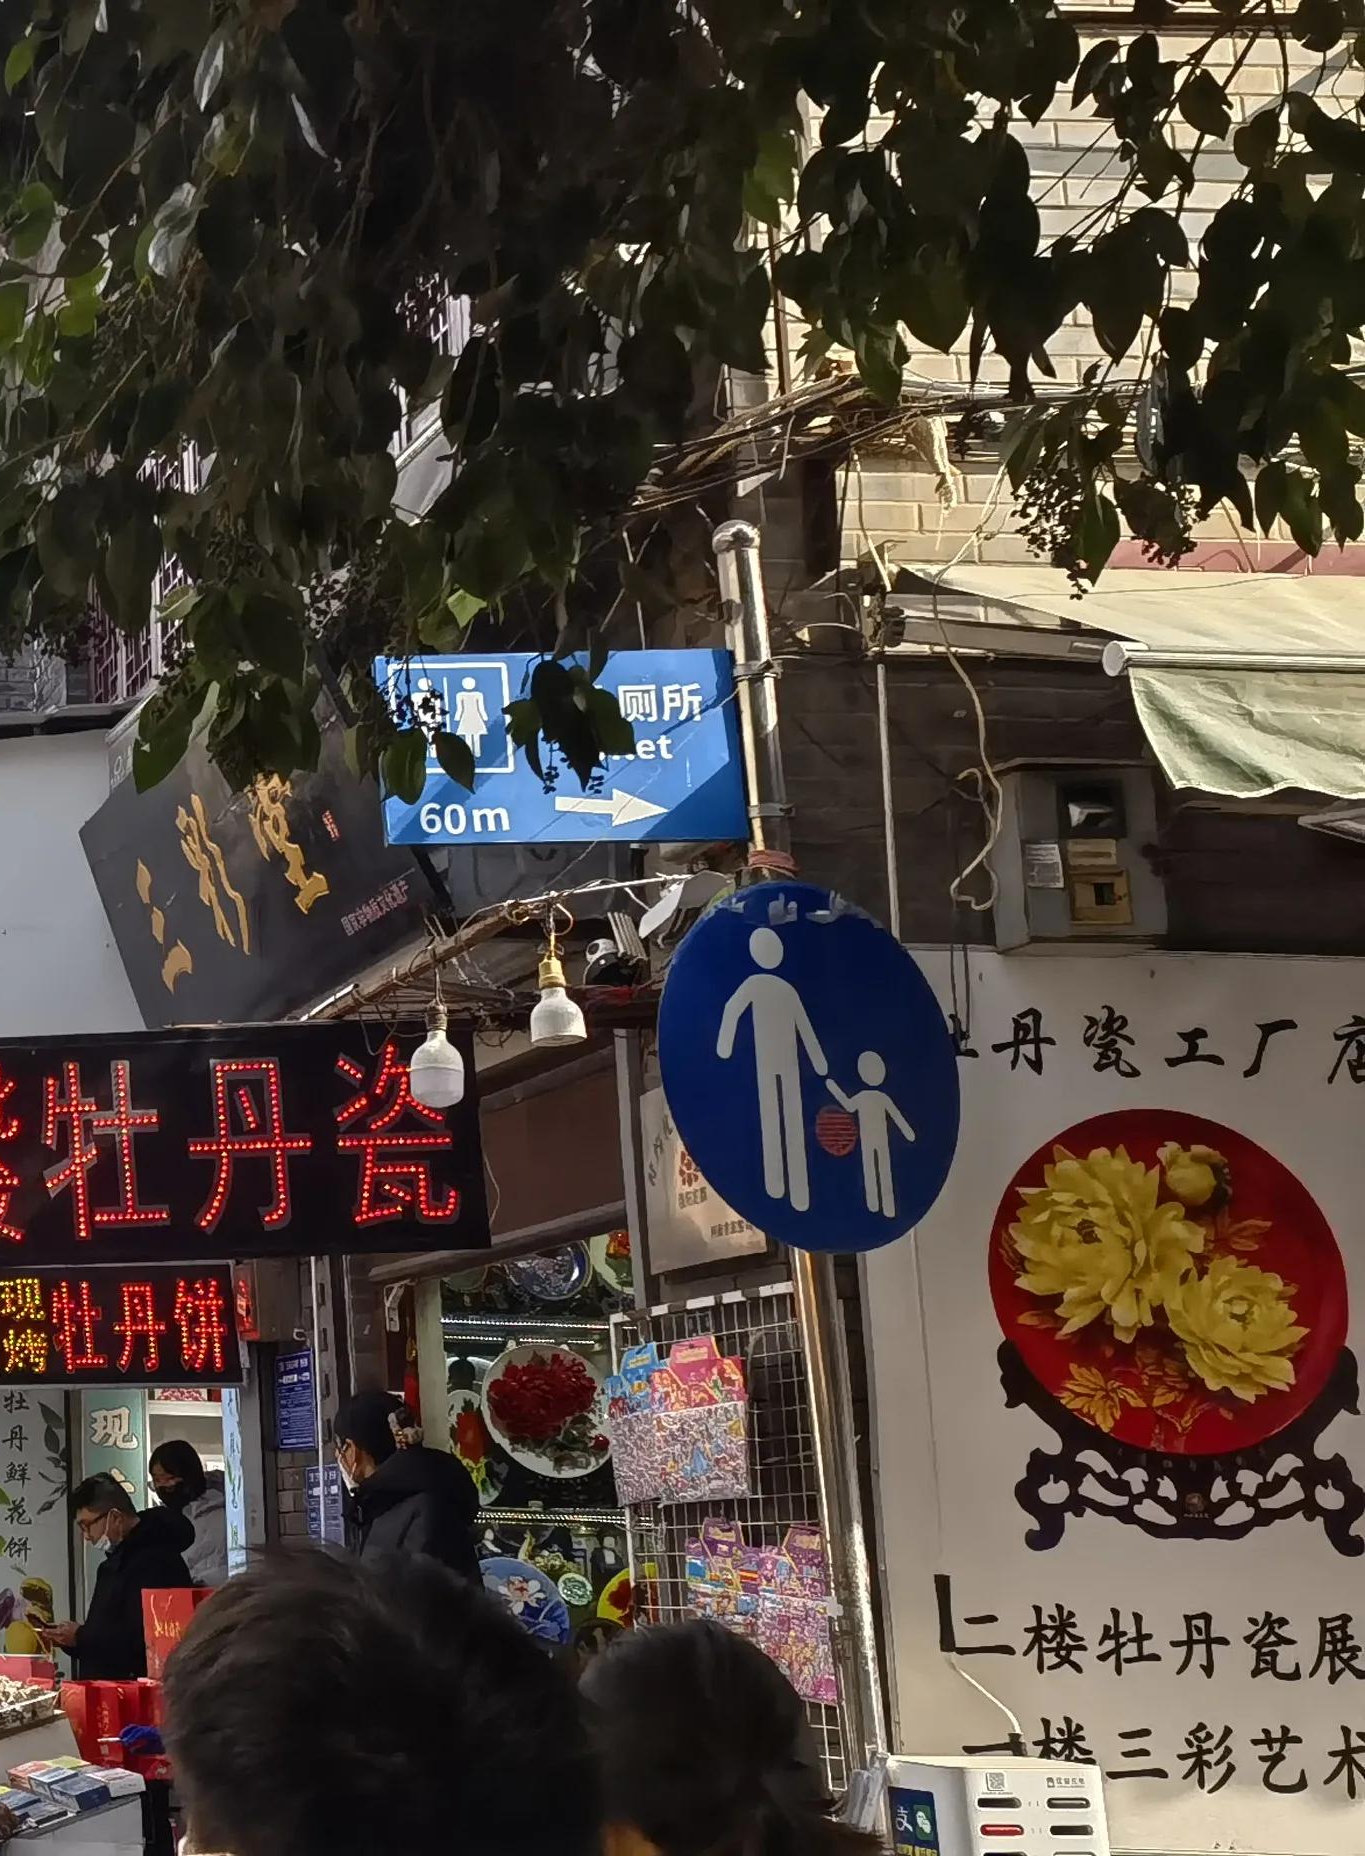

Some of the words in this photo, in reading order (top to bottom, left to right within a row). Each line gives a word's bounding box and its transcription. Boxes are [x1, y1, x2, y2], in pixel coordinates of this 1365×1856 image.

[595, 683, 703, 723] 厕所
[42, 1042, 461, 1241] 牡丹瓷
[0, 1277, 48, 1374] 现烤
[51, 1277, 226, 1374] 牡丹饼
[2, 1390, 32, 1563] 牡丹鲜花饼
[956, 1603, 1365, 1686] 二楼牡丹瓷展
